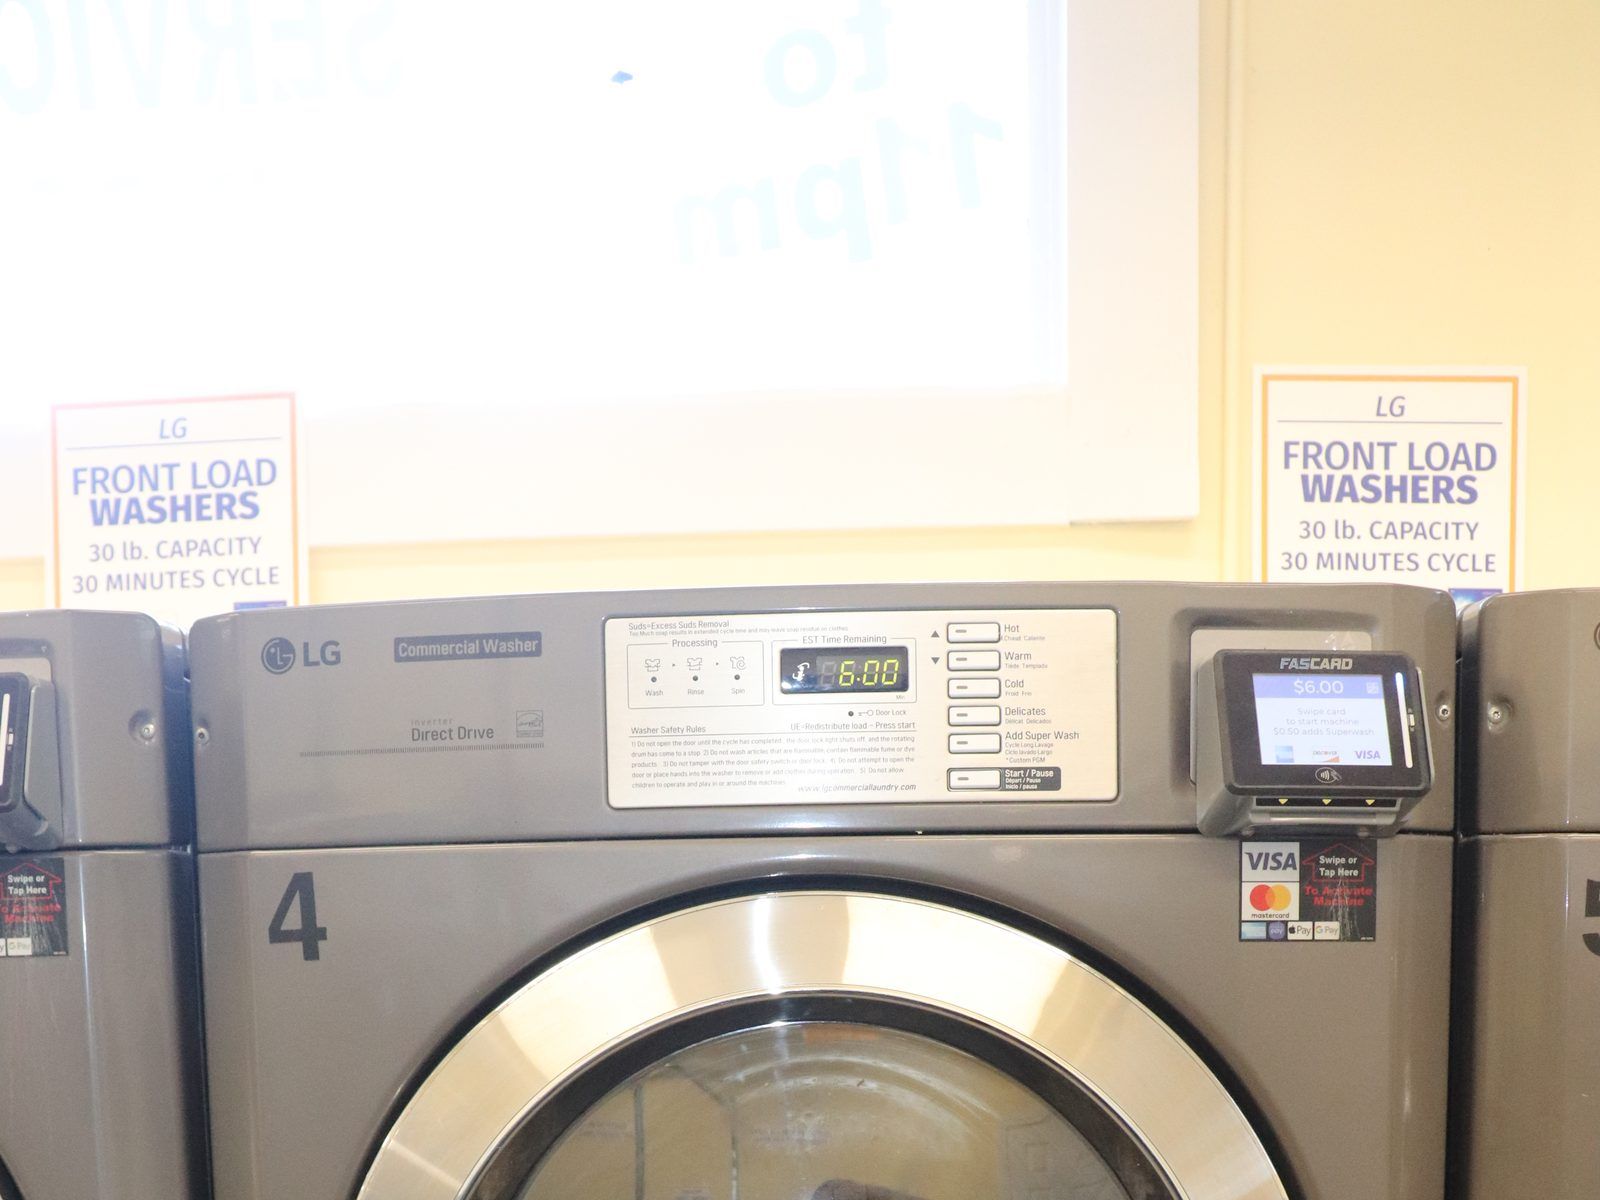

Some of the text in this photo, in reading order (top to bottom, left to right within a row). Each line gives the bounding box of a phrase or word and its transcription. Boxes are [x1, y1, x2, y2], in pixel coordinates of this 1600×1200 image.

[1376, 396, 1406, 418] LG
[159, 417, 188, 439] LG
[1283, 440, 1497, 471] FRONT LOAD
[72, 458, 277, 495] FRONT LOAD
[1301, 474, 1478, 505] WASHERS
[89, 490, 260, 526] WASHERS
[1299, 519, 1479, 541] 30 lb. CAPACITY
[89, 536, 262, 562] 30 lb. CAPACITY
[1281, 552, 1496, 573] 30 MINUTES CYCLE
[72, 566, 280, 594] 30 MINUTES CYCLE
[679, 621, 697, 630] Suds
[698, 620, 730, 629] Removal
[1004, 624, 1020, 633] Hot
[672, 639, 718, 648] Processing
[803, 635, 887, 644] EST Time Remaining
[303, 640, 342, 667] LG
[399, 638, 538, 657] Commercial Washer
[1004, 651, 1032, 660] Warm
[1280, 658, 1353, 669] FASCARD
[1004, 679, 1024, 688] Cold
[1293, 679, 1343, 694] $6.00
[1004, 707, 1046, 716] Delicates
[411, 726, 494, 741] Direct Drive
[631, 725, 706, 735] Washer Safety Rules
[1005, 731, 1080, 741] Add Super Wash
[1355, 751, 1381, 759] VISA
[1244, 852, 1297, 870] VISA
[1319, 856, 1346, 865] Swipe
[8, 875, 33, 883] Swipe
[1320, 868, 1358, 878] Tap Here
[8, 886, 47, 895] Tap Here
[267, 872, 328, 961] 4
[1297, 926, 1312, 936] Pay
